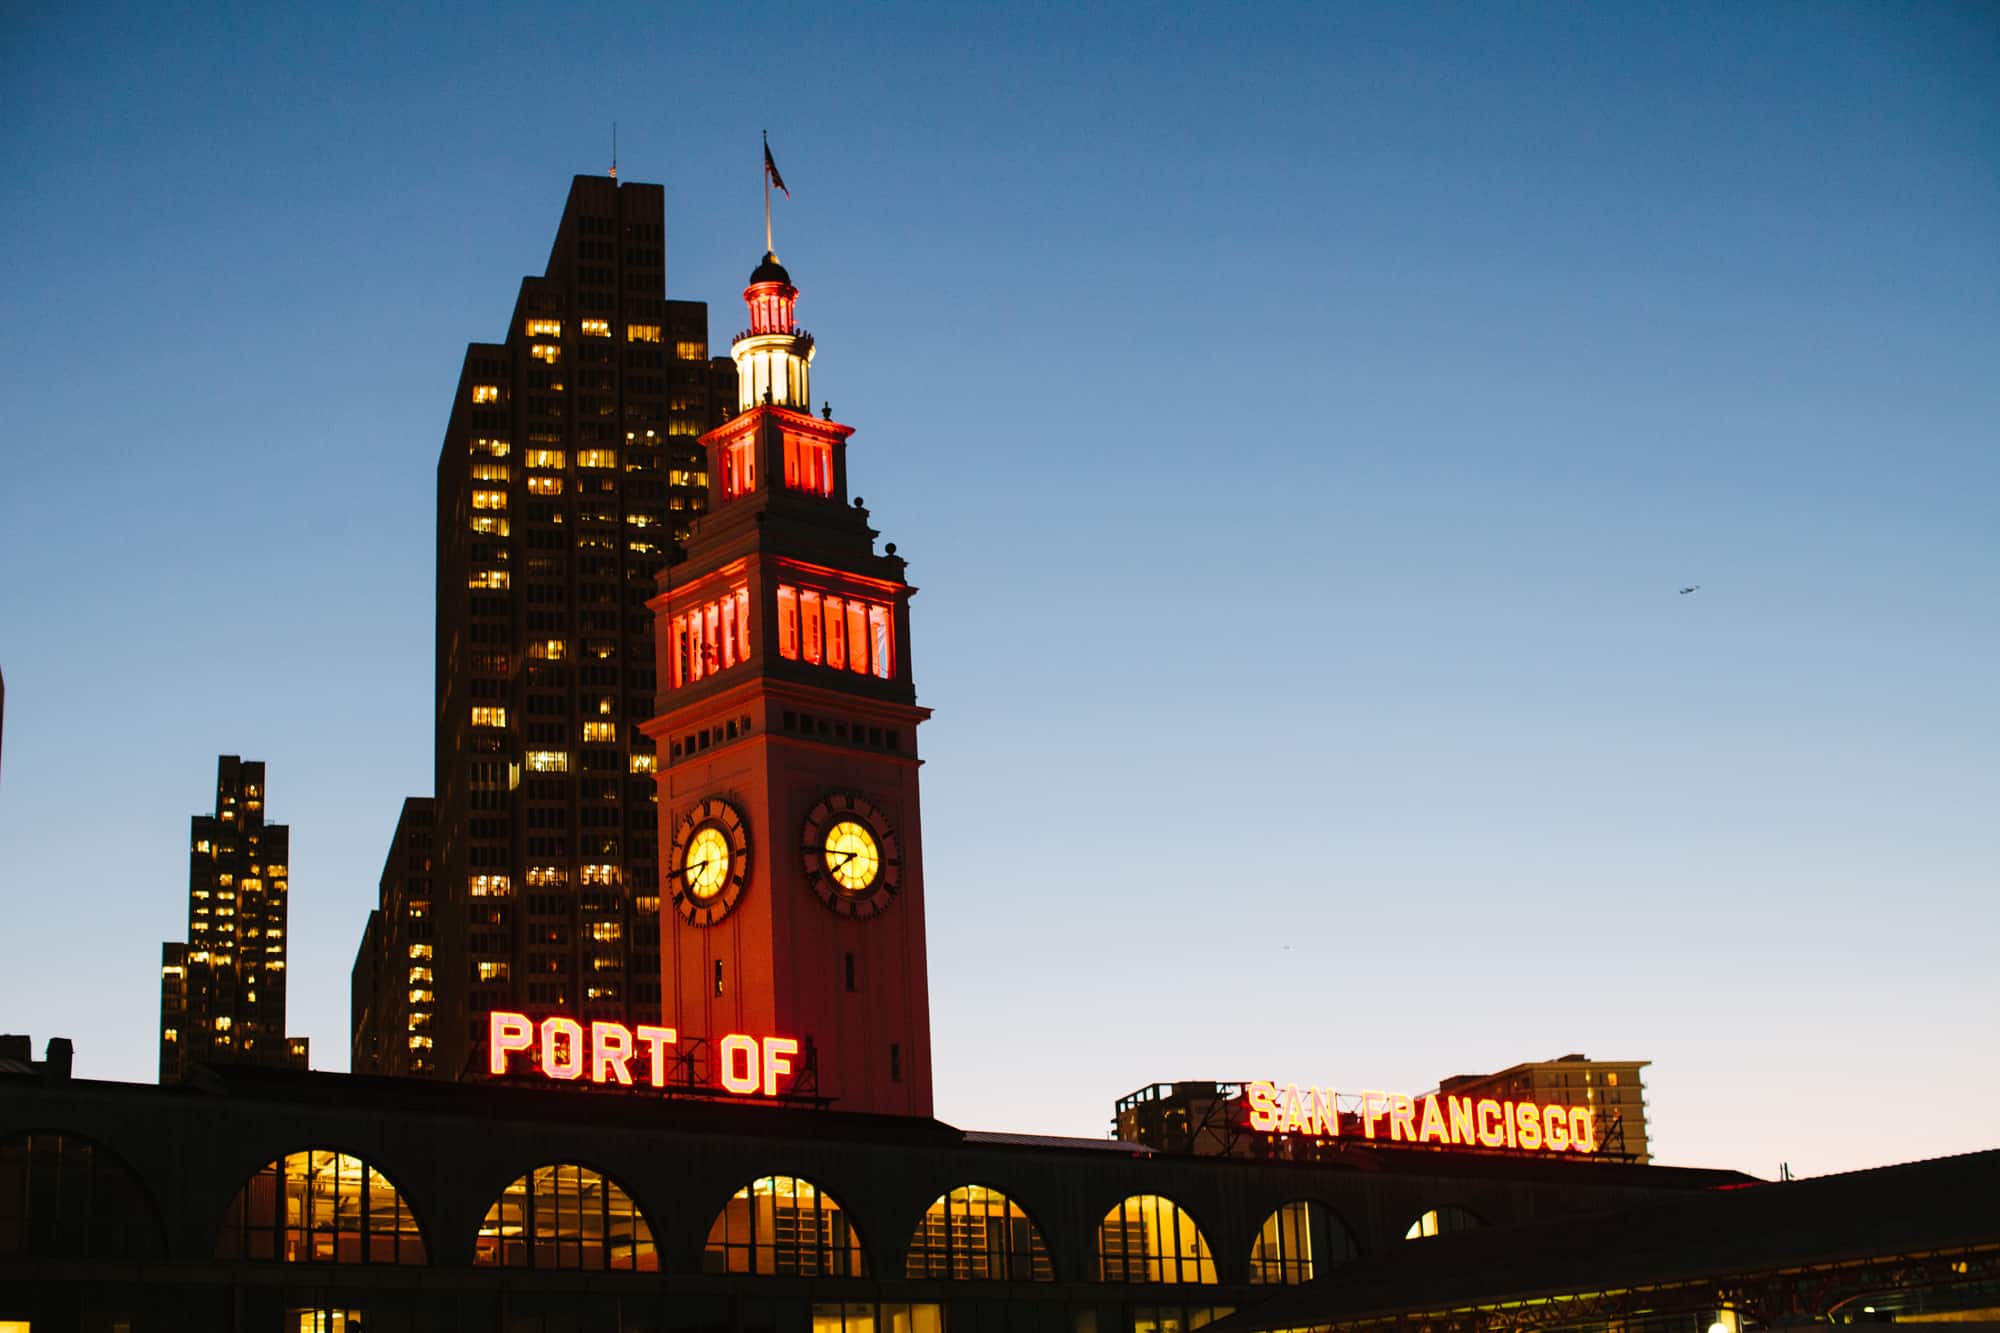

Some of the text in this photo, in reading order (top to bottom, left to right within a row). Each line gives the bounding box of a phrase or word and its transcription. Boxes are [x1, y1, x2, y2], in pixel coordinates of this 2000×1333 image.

[490, 1011, 798, 1096] PORT OF
[1248, 1081, 1595, 1153] SAN FRANCISCO
